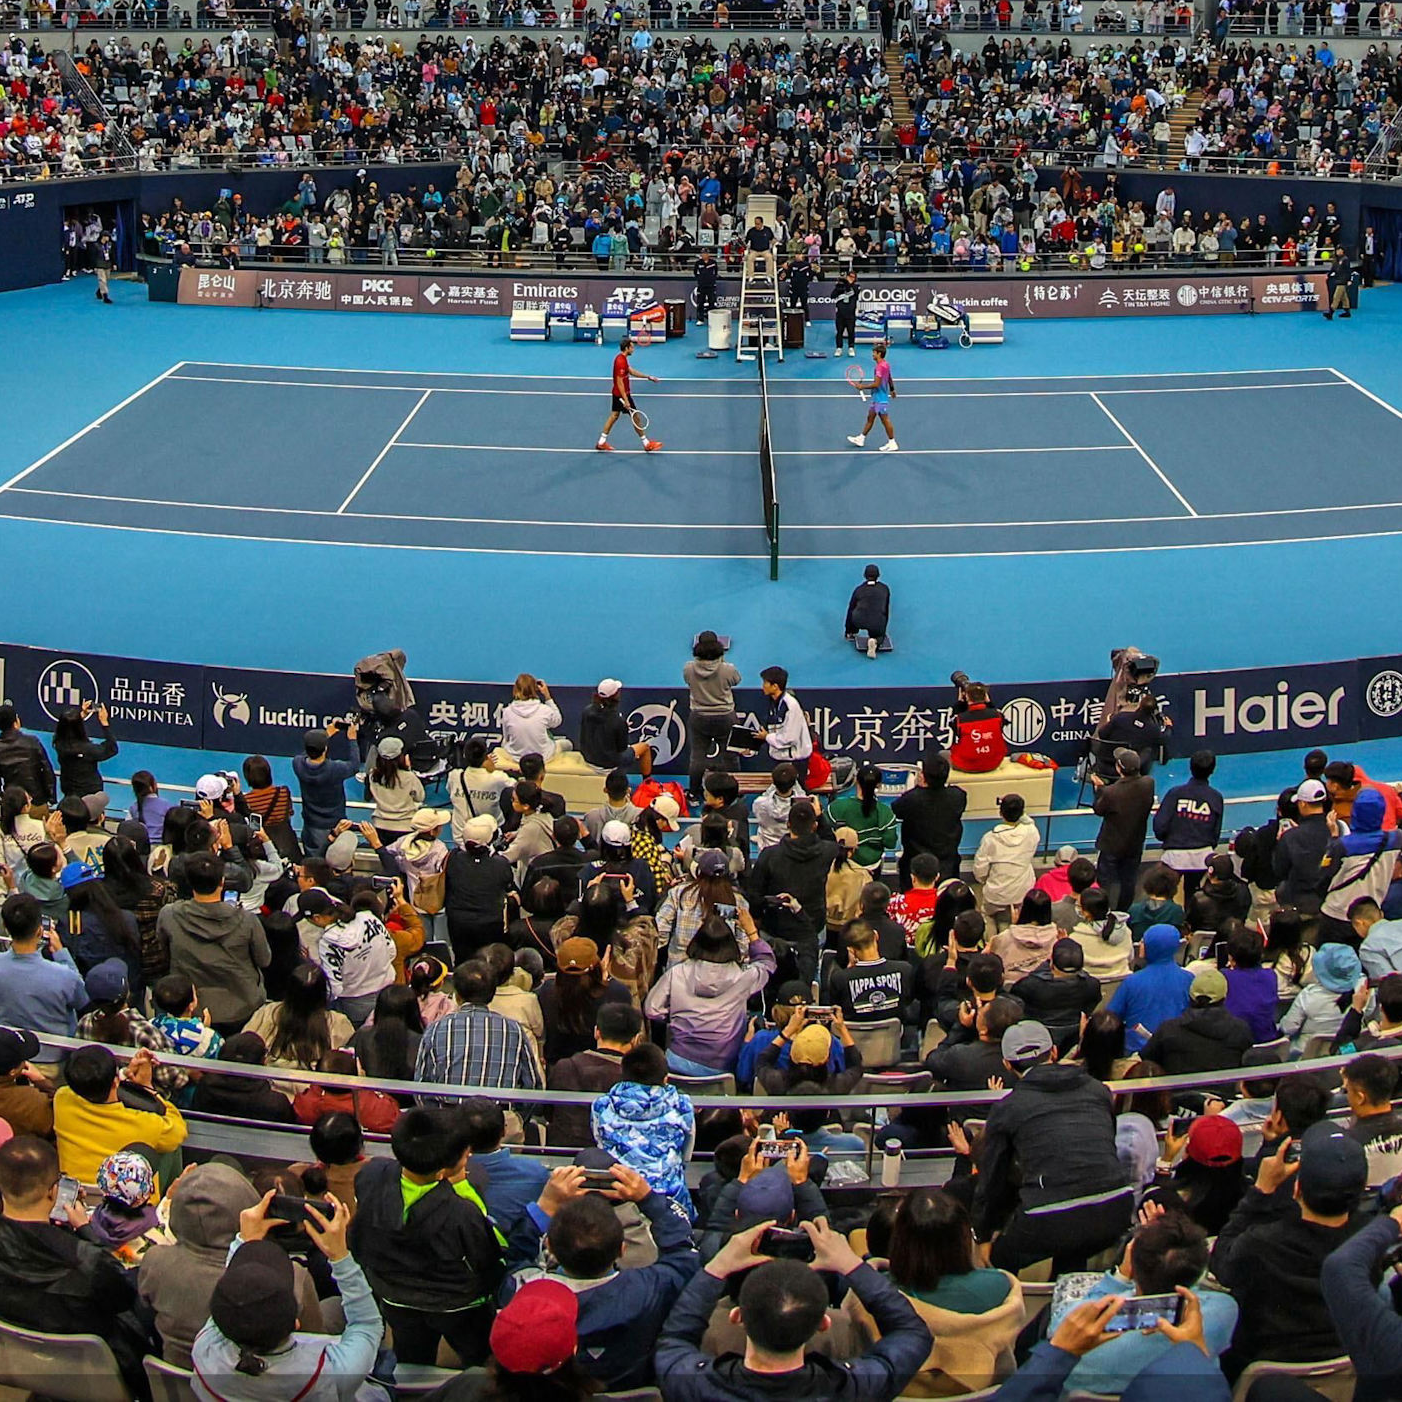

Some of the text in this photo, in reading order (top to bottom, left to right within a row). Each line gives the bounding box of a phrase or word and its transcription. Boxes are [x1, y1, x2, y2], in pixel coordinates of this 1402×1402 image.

[198, 274, 236, 292] 昆仑山
[260, 278, 332, 300] 北京奔驰
[362, 279, 394, 292] PICC
[513, 282, 578, 298] Emirates
[1266, 282, 1315, 294] 央视体育
[448, 286, 499, 299] 嘉实基金
[606, 286, 654, 302] ATP
[1034, 284, 1072, 300] 特仑苏
[1123, 289, 1170, 301] 天坛整装
[1198, 285, 1249, 298] 中信银行
[1282, 294, 1320, 303] SPORTS
[341, 294, 414, 307] 中国人民保险
[981, 298, 1008, 306] coffee
[110, 677, 186, 706] 品品香
[110, 705, 194, 726] PINPINTEA
[258, 706, 318, 728] luckin
[1194, 681, 1345, 738] Haier
[1051, 729, 1092, 742] CHINA
[976, 745, 990, 754] 143
[1177, 798, 1211, 815] FILA
[849, 972, 902, 1002] KAPPA SPORT
